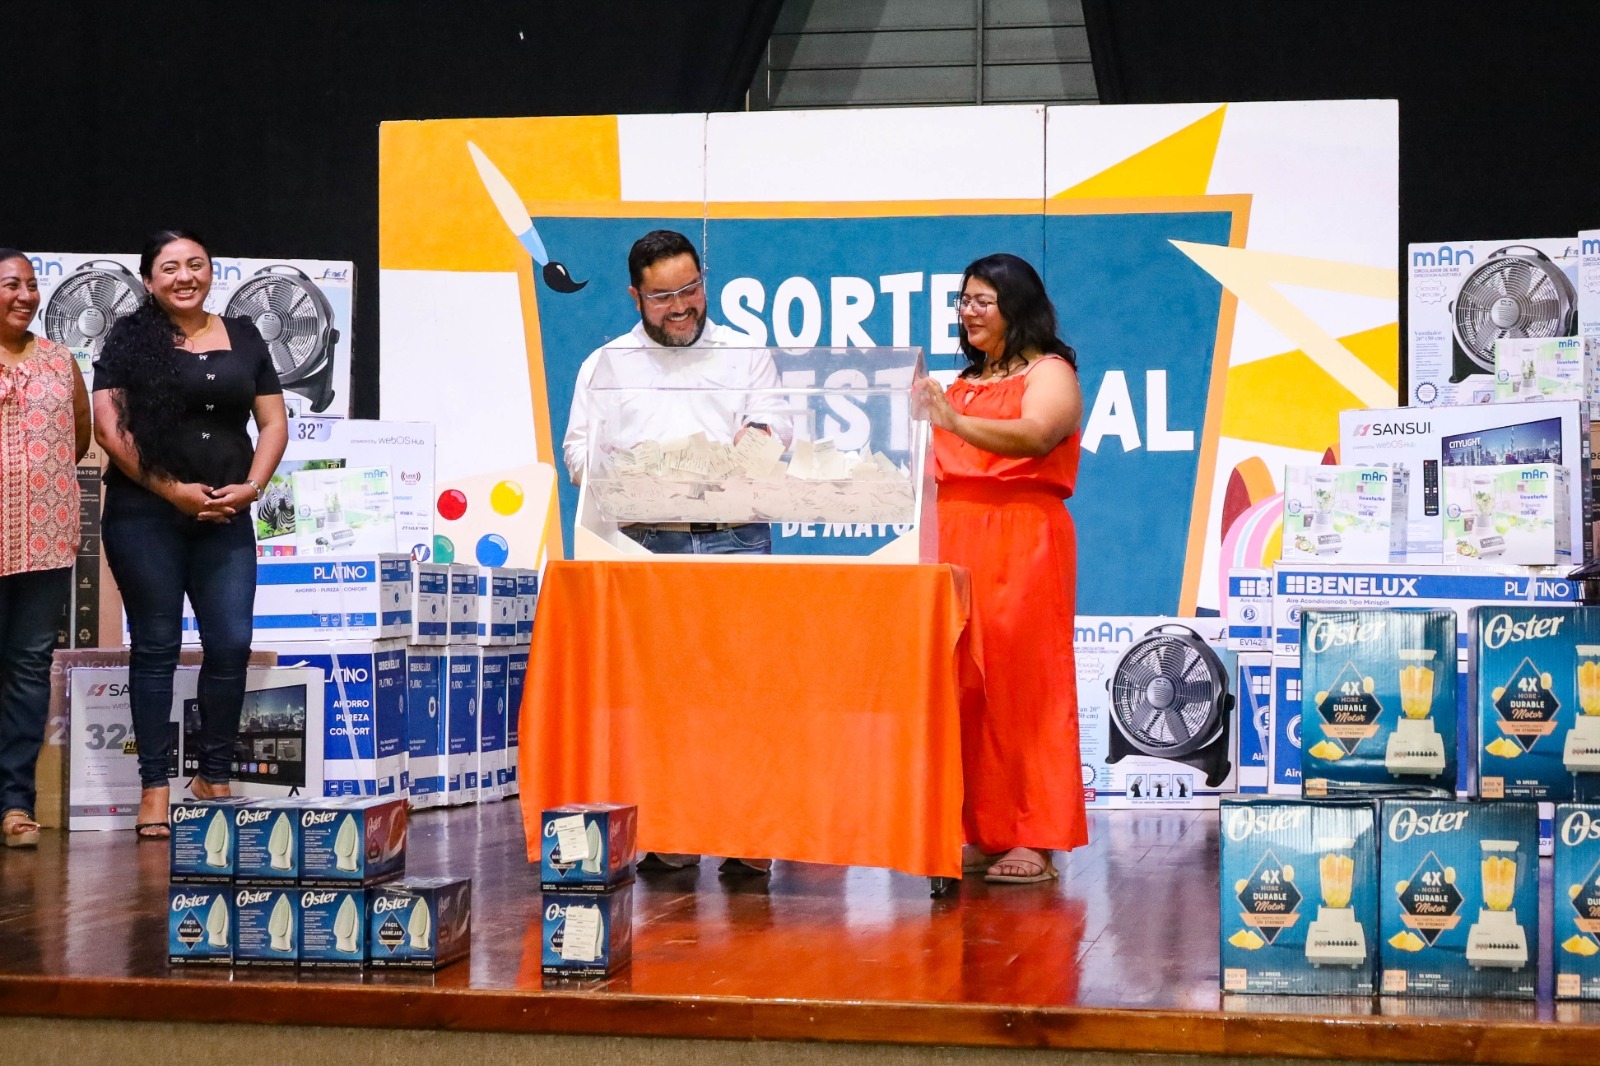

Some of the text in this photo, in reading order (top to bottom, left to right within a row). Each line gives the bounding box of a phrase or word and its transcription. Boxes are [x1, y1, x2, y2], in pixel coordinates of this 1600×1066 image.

[1413, 245, 1475, 267] mAn
[721, 271, 963, 355] SORTE
[1558, 340, 1580, 348] mAn
[1372, 421, 1432, 437] SANSUI
[1448, 437, 1482, 449] CITYLIGHT
[363, 470, 389, 479] mAn
[1361, 471, 1388, 482] mAn
[1521, 468, 1549, 480] mAn
[313, 564, 367, 581] PLATINO
[1306, 575, 1569, 598] BENELUX PLATINO
[1074, 621, 1134, 643] mAn
[1308, 619, 1387, 654] Oster
[1484, 613, 1566, 650] Oster
[1340, 681, 1361, 696] 4X
[1517, 677, 1539, 693] 4X
[112, 702, 131, 711] web
[1333, 704, 1368, 712] DURABLE
[1510, 700, 1546, 709] DURABLE
[1334, 711, 1366, 723] Motor
[1511, 708, 1544, 720] Motor
[329, 727, 370, 736] CONORT
[1252, 752, 1265, 761] Air
[172, 806, 209, 824] Oster
[235, 809, 273, 828] Oster
[301, 810, 339, 828] Oster
[1227, 806, 1308, 842] Oster
[1388, 807, 1470, 843] Oster
[1260, 869, 1281, 885] 4X
[1420, 871, 1442, 887] 4X
[171, 893, 210, 912] Oster
[235, 889, 273, 909] Oster
[301, 890, 339, 909] Oster
[1252, 892, 1288, 901] DURABLE
[1413, 894, 1450, 903] DURABLE
[373, 896, 412, 915] Oster
[1253, 901, 1286, 912] Motor
[1415, 902, 1447, 914] Motor
